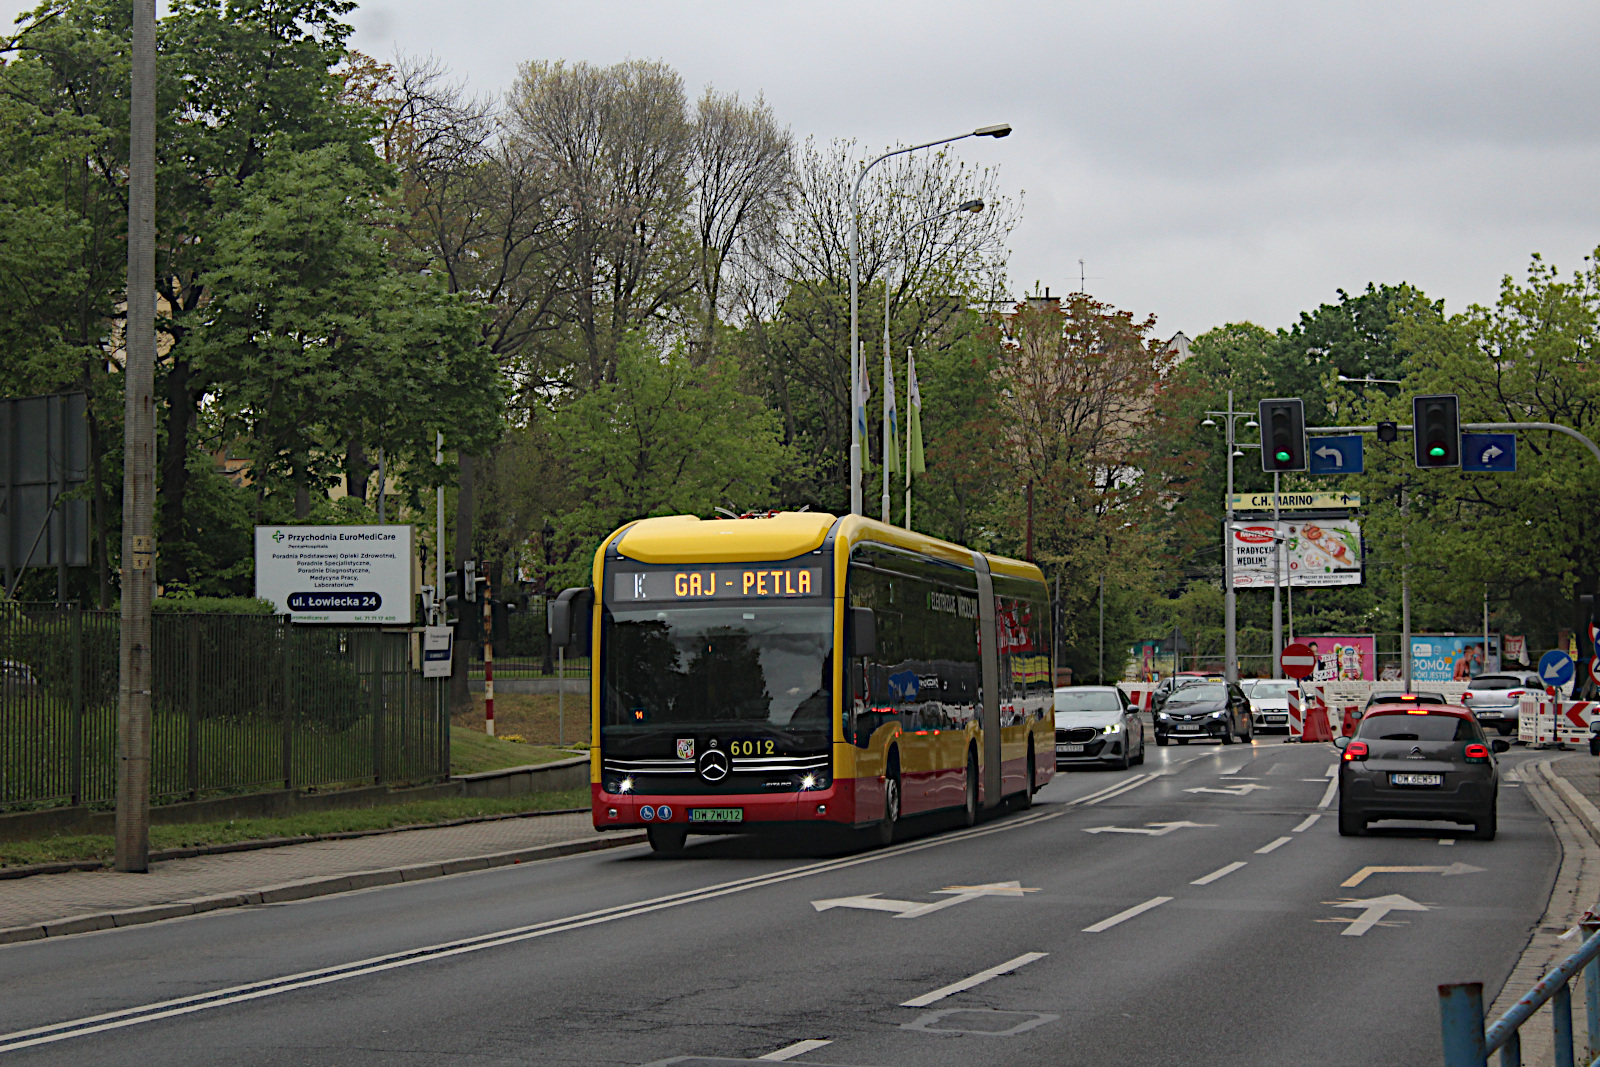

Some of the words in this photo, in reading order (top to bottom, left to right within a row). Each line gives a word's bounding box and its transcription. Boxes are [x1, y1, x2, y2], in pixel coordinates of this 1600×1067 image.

[1252, 496, 1271, 506] C.H.
[288, 534, 337, 542] Przychodnia
[1237, 557, 1267, 566] WĘDLINY
[675, 572, 715, 596] GAJ
[743, 570, 811, 596] PĘTLA
[292, 597, 305, 606] ul.
[308, 597, 359, 606] Łowiecka
[362, 597, 376, 606] 24
[731, 740, 774, 755] 6012
[1397, 775, 1408, 783] DW
[694, 810, 707, 820] DW
[711, 810, 740, 820] 7WU12
